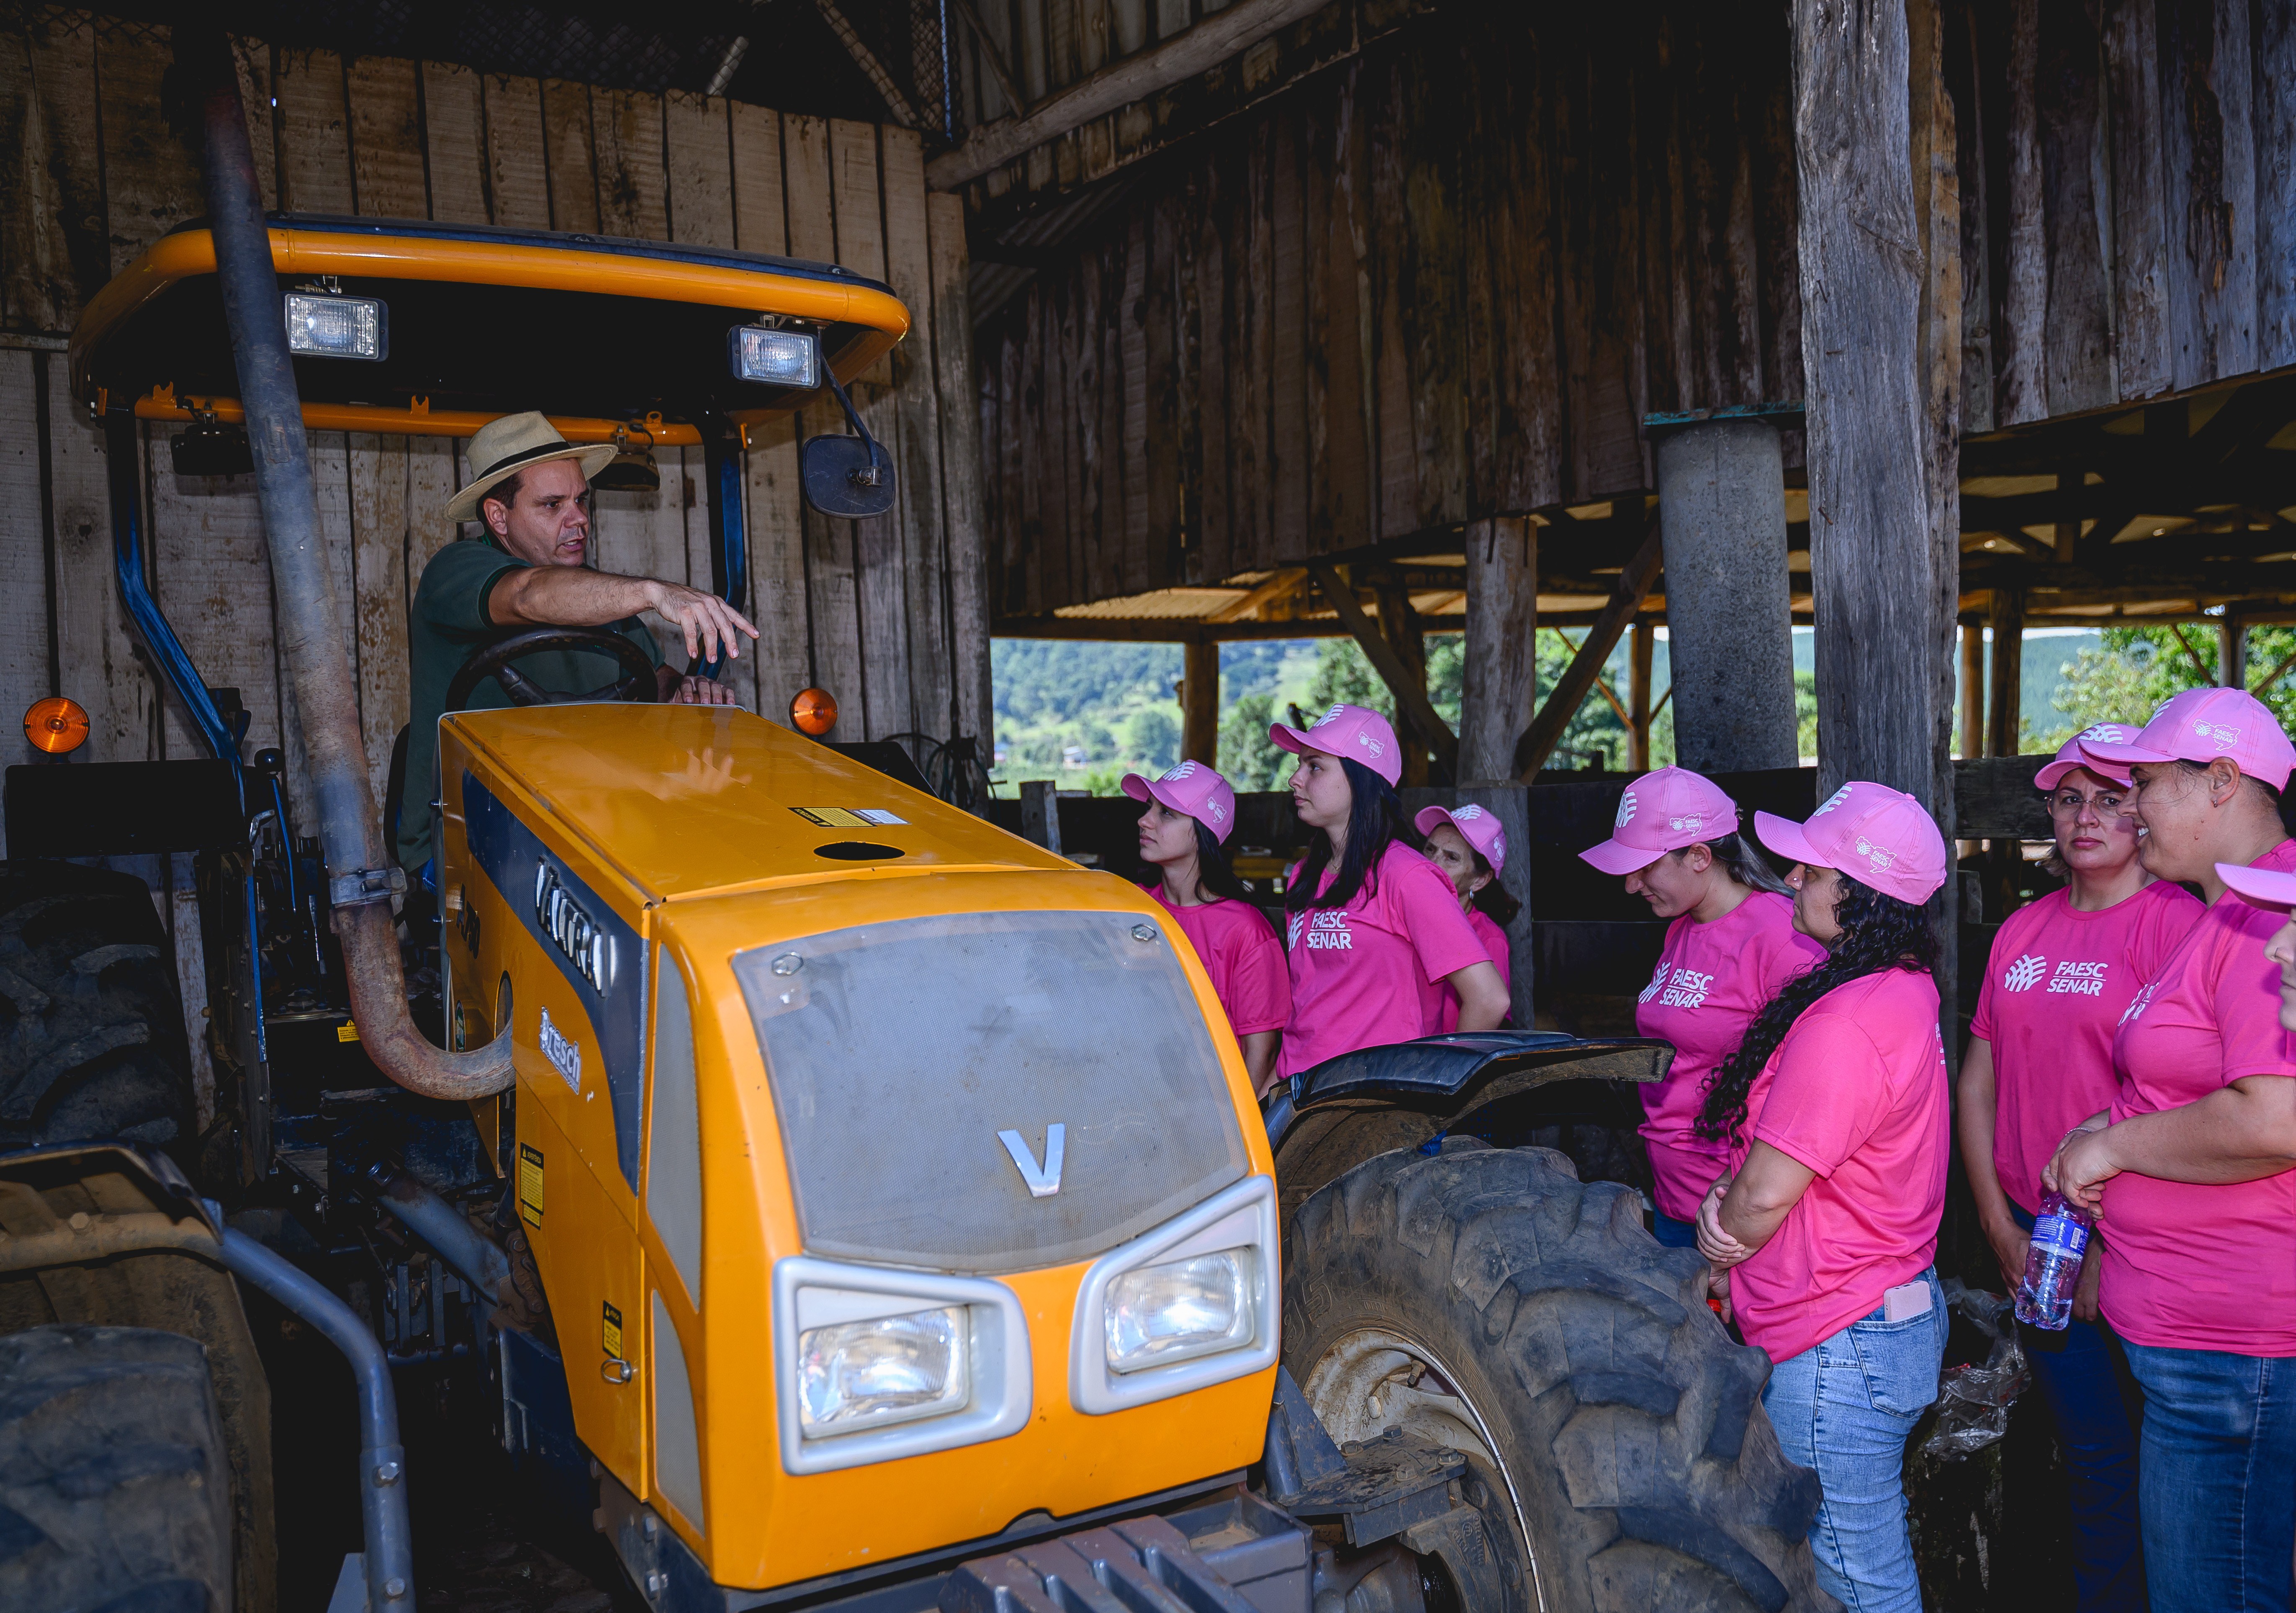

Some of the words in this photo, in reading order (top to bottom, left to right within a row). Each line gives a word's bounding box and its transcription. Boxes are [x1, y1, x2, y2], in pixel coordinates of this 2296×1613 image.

[2212, 733, 2233, 744] SENAR
[2214, 728, 2234, 739] FAESC
[1869, 855, 1887, 868] SENAR
[1872, 850, 1890, 862] FAESC
[535, 855, 605, 999] VALTRA
[1311, 911, 1348, 928] FAESC
[1306, 932, 1353, 949] SENAR
[2054, 961, 2108, 978] FAESC
[1669, 968, 1714, 991] FAESC
[2046, 978, 2103, 997] SENAR
[1658, 988, 1705, 1008] SENAR
[997, 1122, 1065, 1199] V
